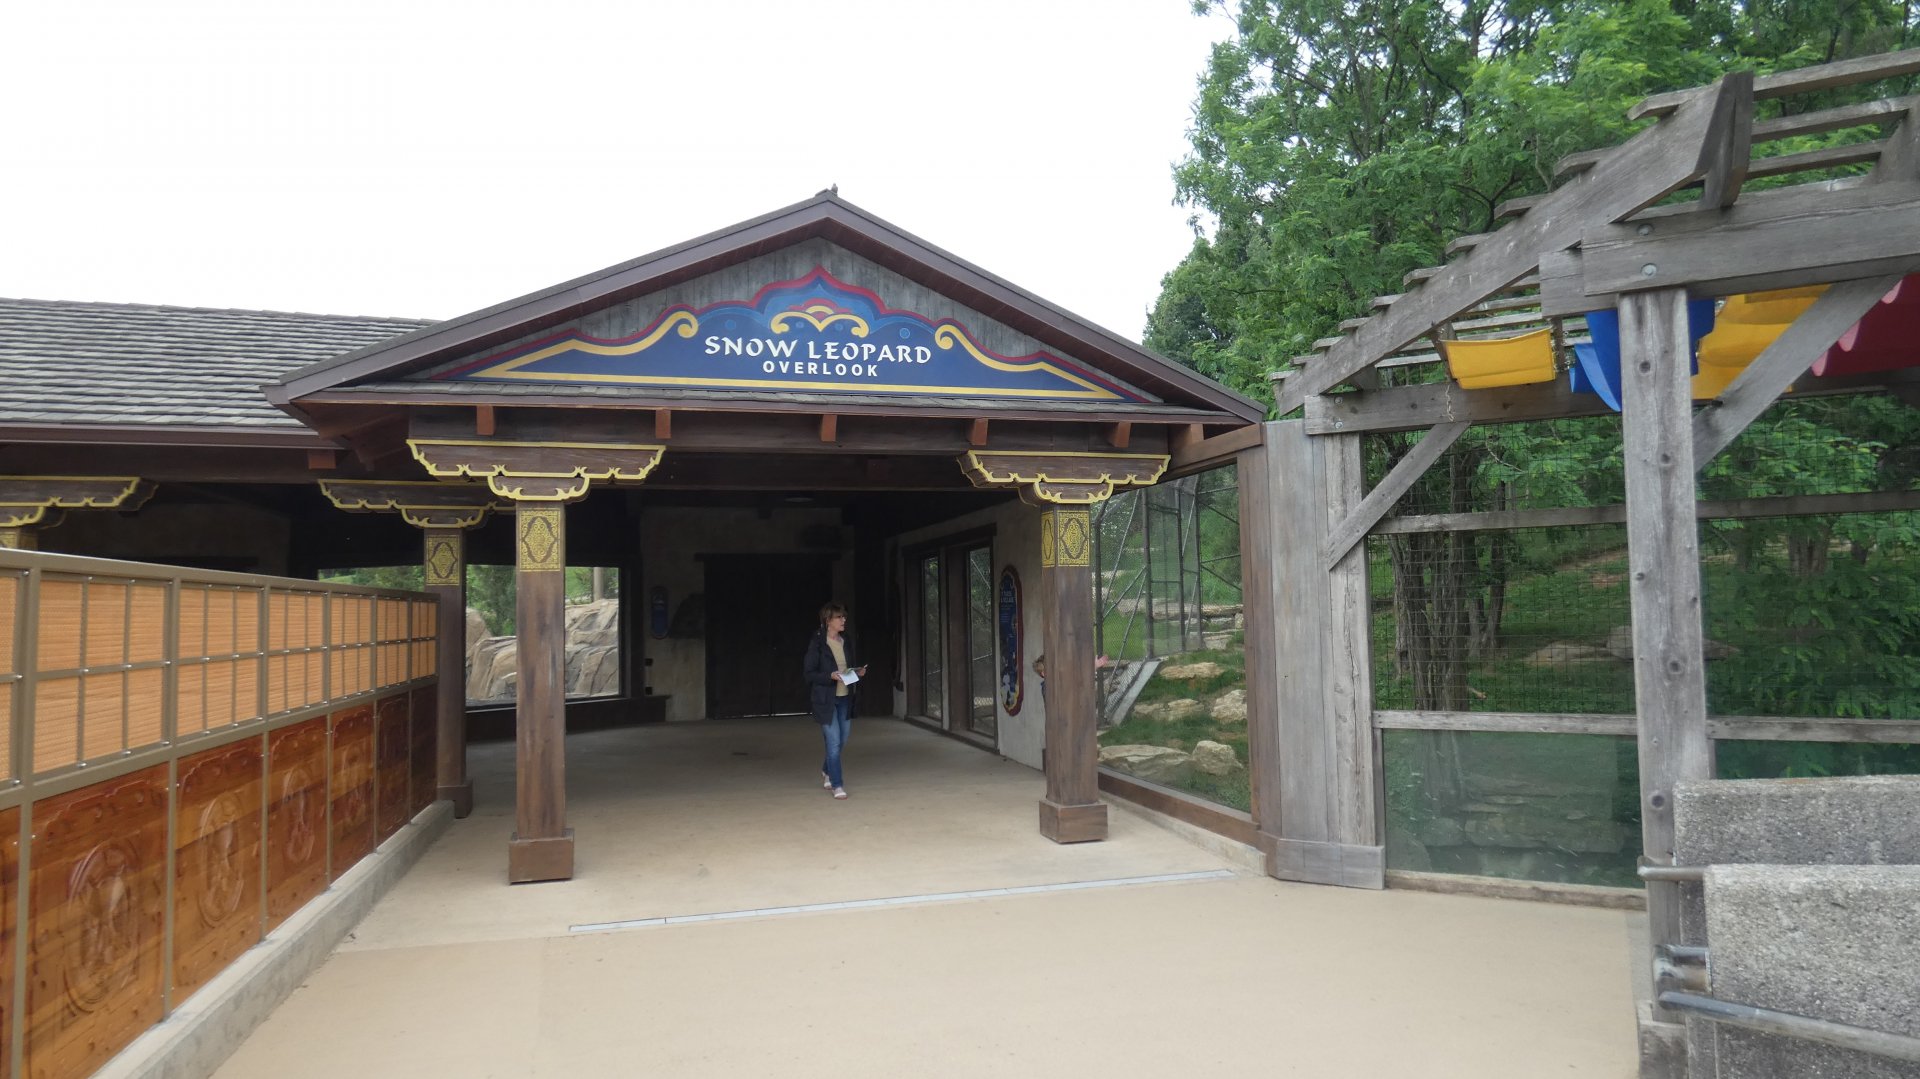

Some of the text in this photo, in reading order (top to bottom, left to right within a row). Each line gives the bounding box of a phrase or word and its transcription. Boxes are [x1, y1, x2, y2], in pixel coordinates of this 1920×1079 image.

[705, 336, 931, 363] SNOW LEOPARD
[763, 361, 878, 377] OVERLOOK
